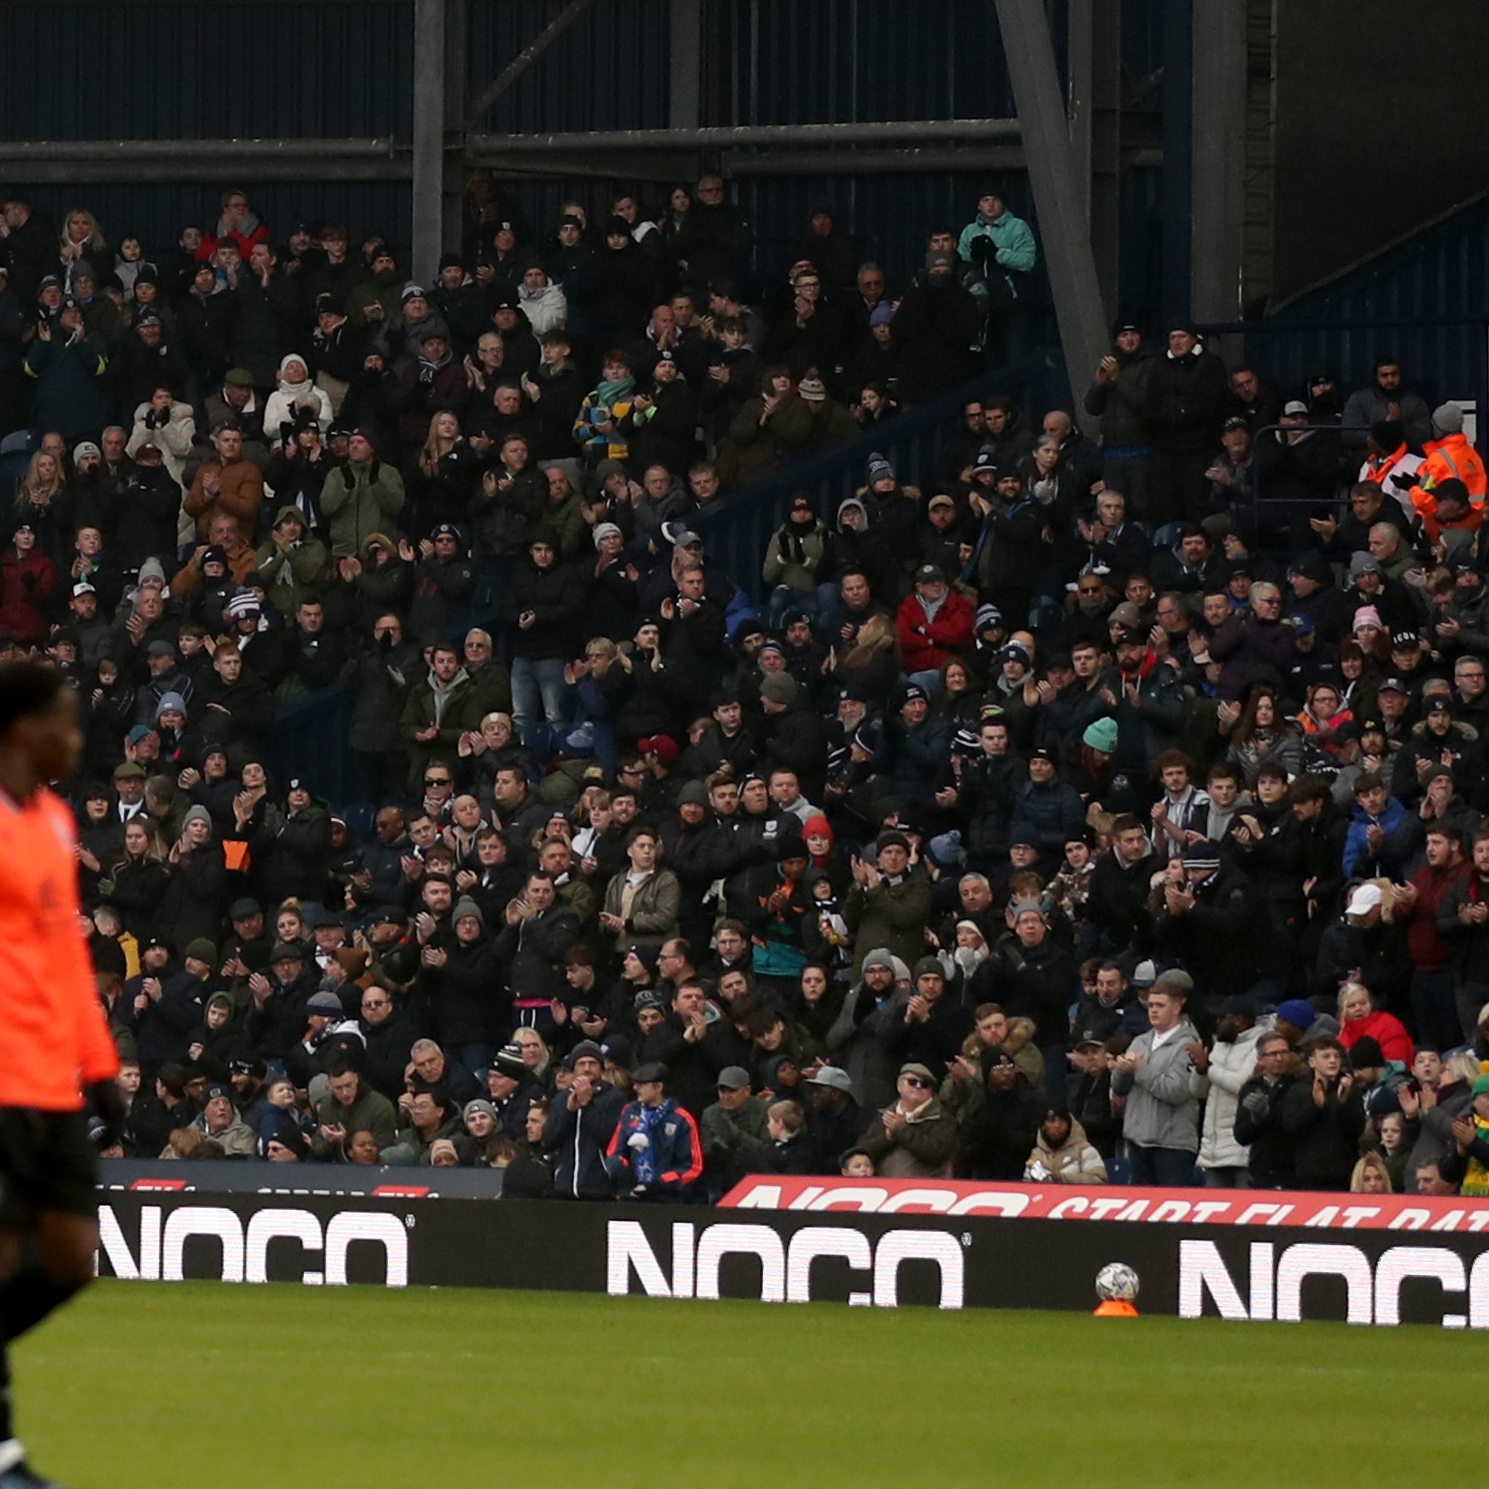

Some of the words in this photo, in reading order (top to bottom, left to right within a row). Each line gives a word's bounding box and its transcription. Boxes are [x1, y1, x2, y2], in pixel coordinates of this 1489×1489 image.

[93, 1205, 409, 1288] NOCO
[607, 1220, 964, 1310] NOCO
[1179, 1239, 1489, 1329] NOC
